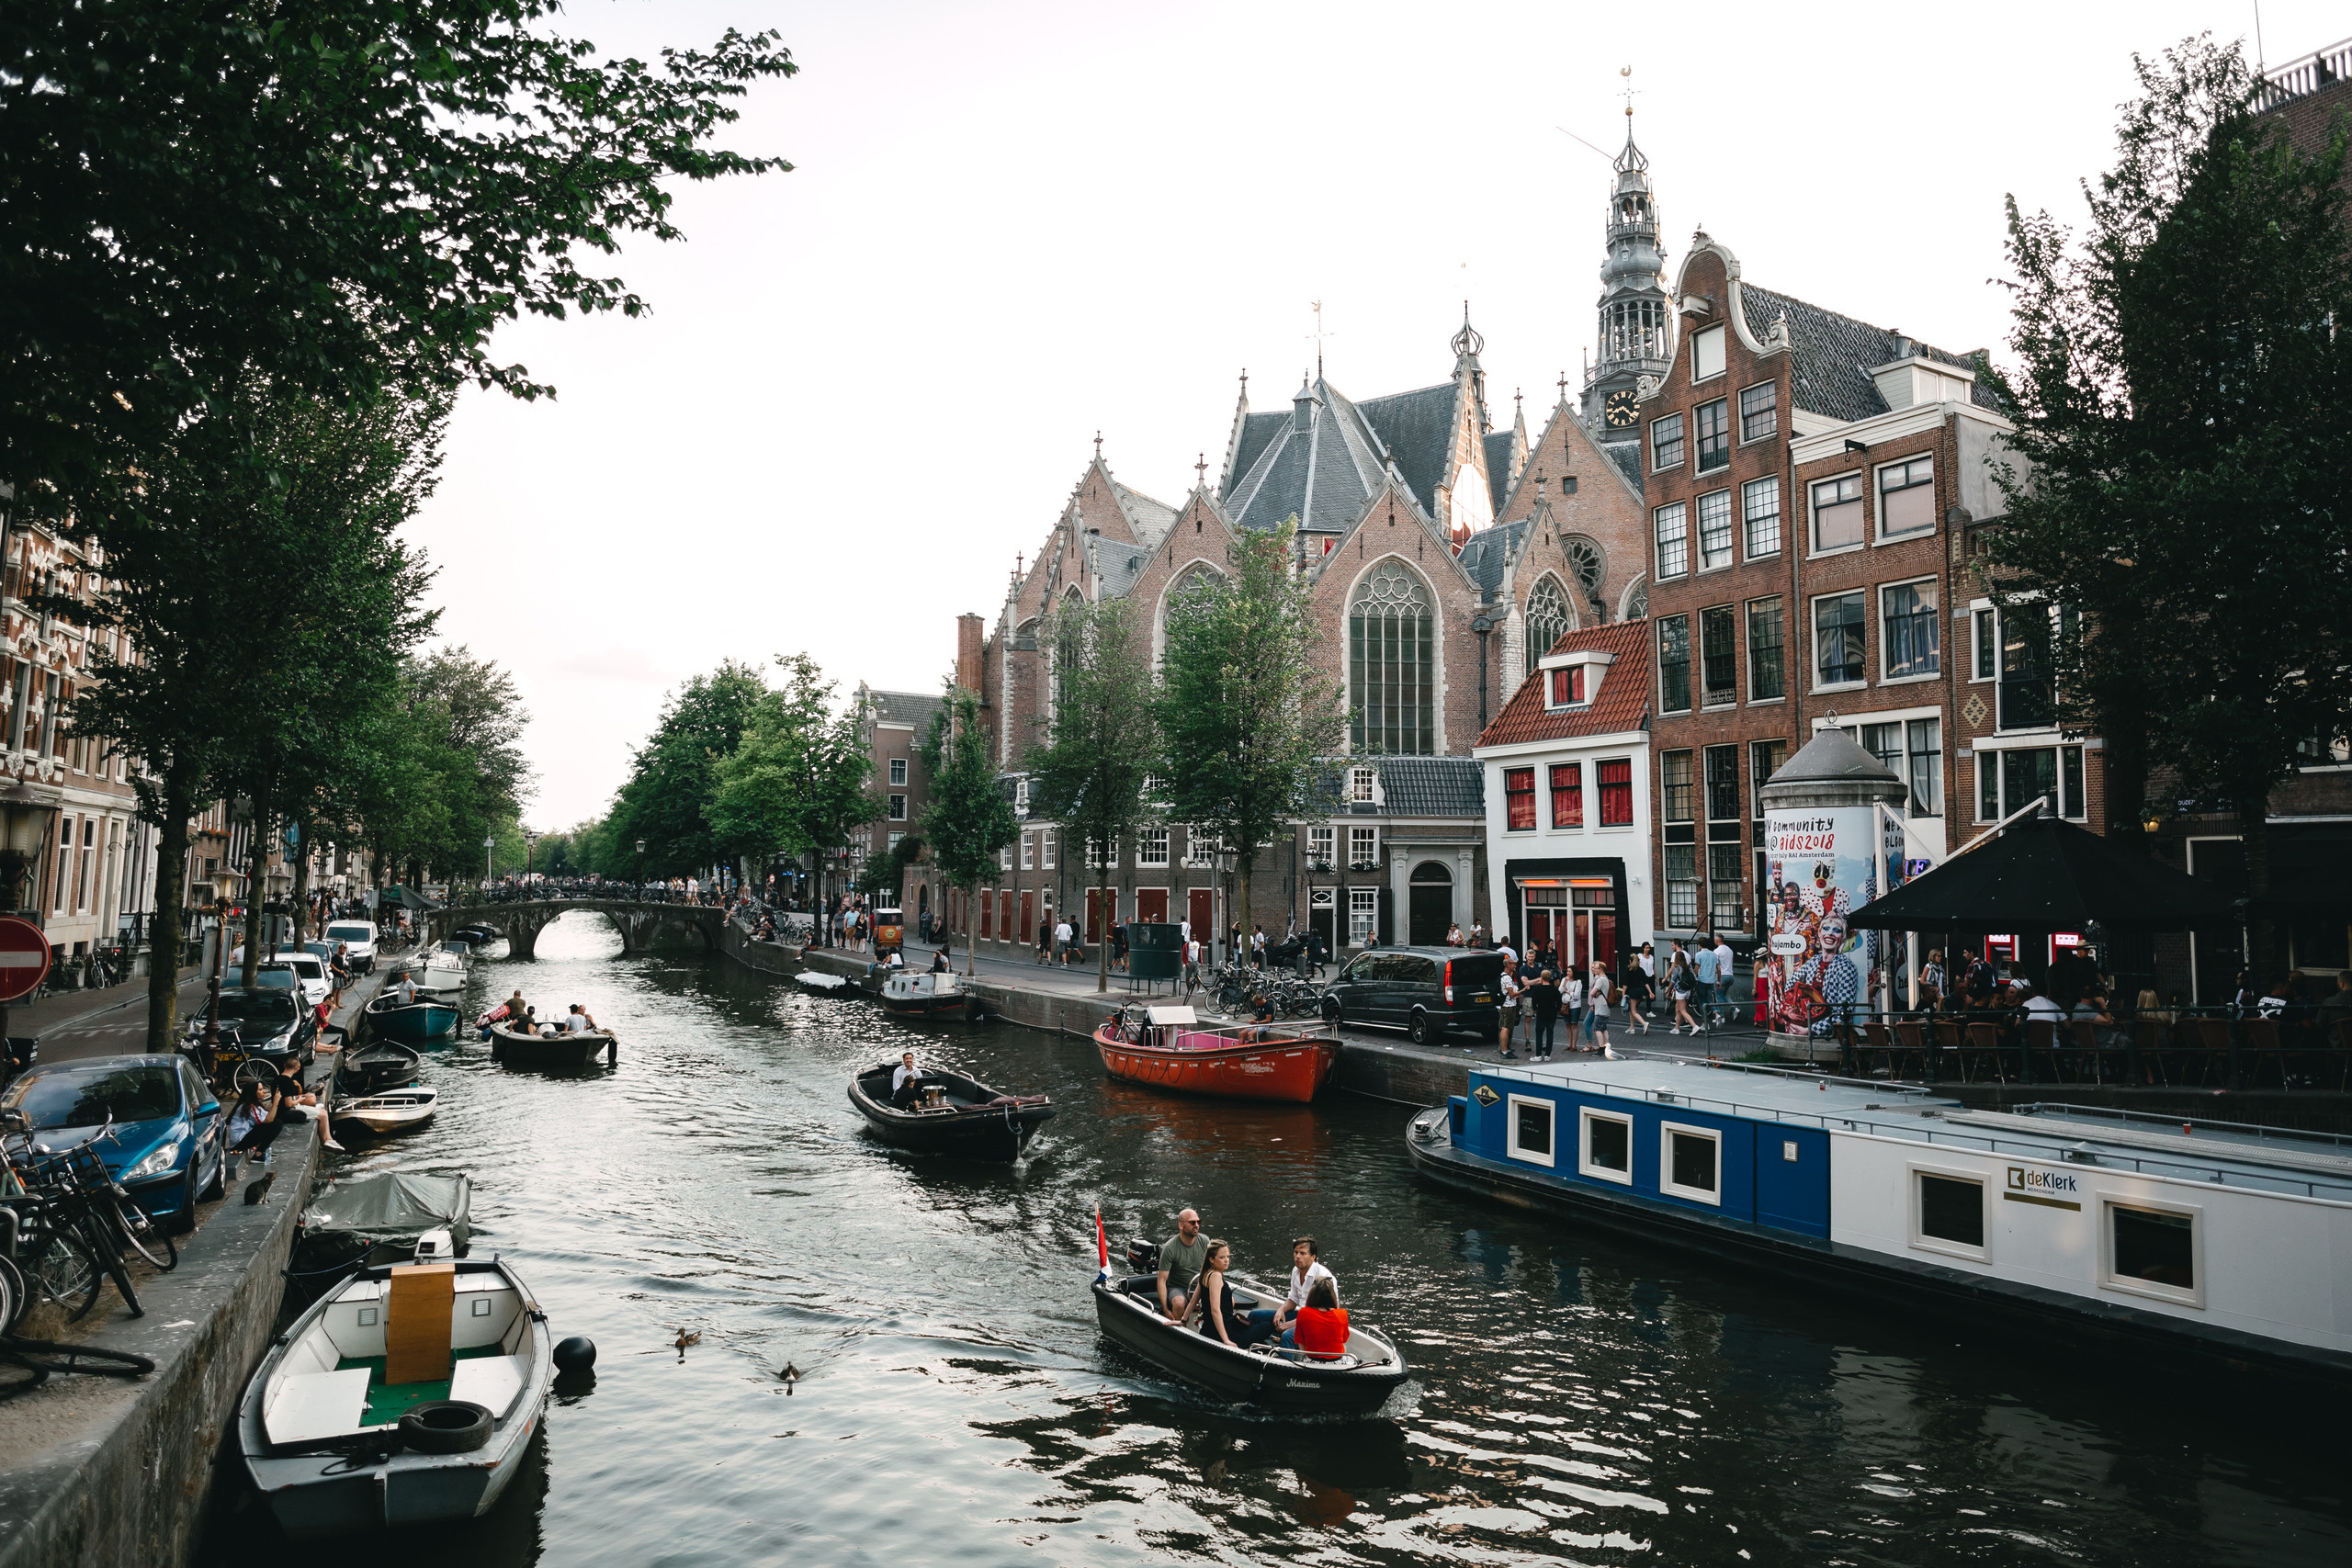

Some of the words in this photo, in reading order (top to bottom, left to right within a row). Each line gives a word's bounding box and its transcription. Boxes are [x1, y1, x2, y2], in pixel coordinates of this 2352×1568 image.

[1773, 818, 1834, 832] community
[1780, 833, 1835, 851] aids2018
[1481, 1089, 1490, 1097] PK
[2027, 1170, 2076, 1191] deKlerk
[1286, 1378, 1321, 1389] Maxime
